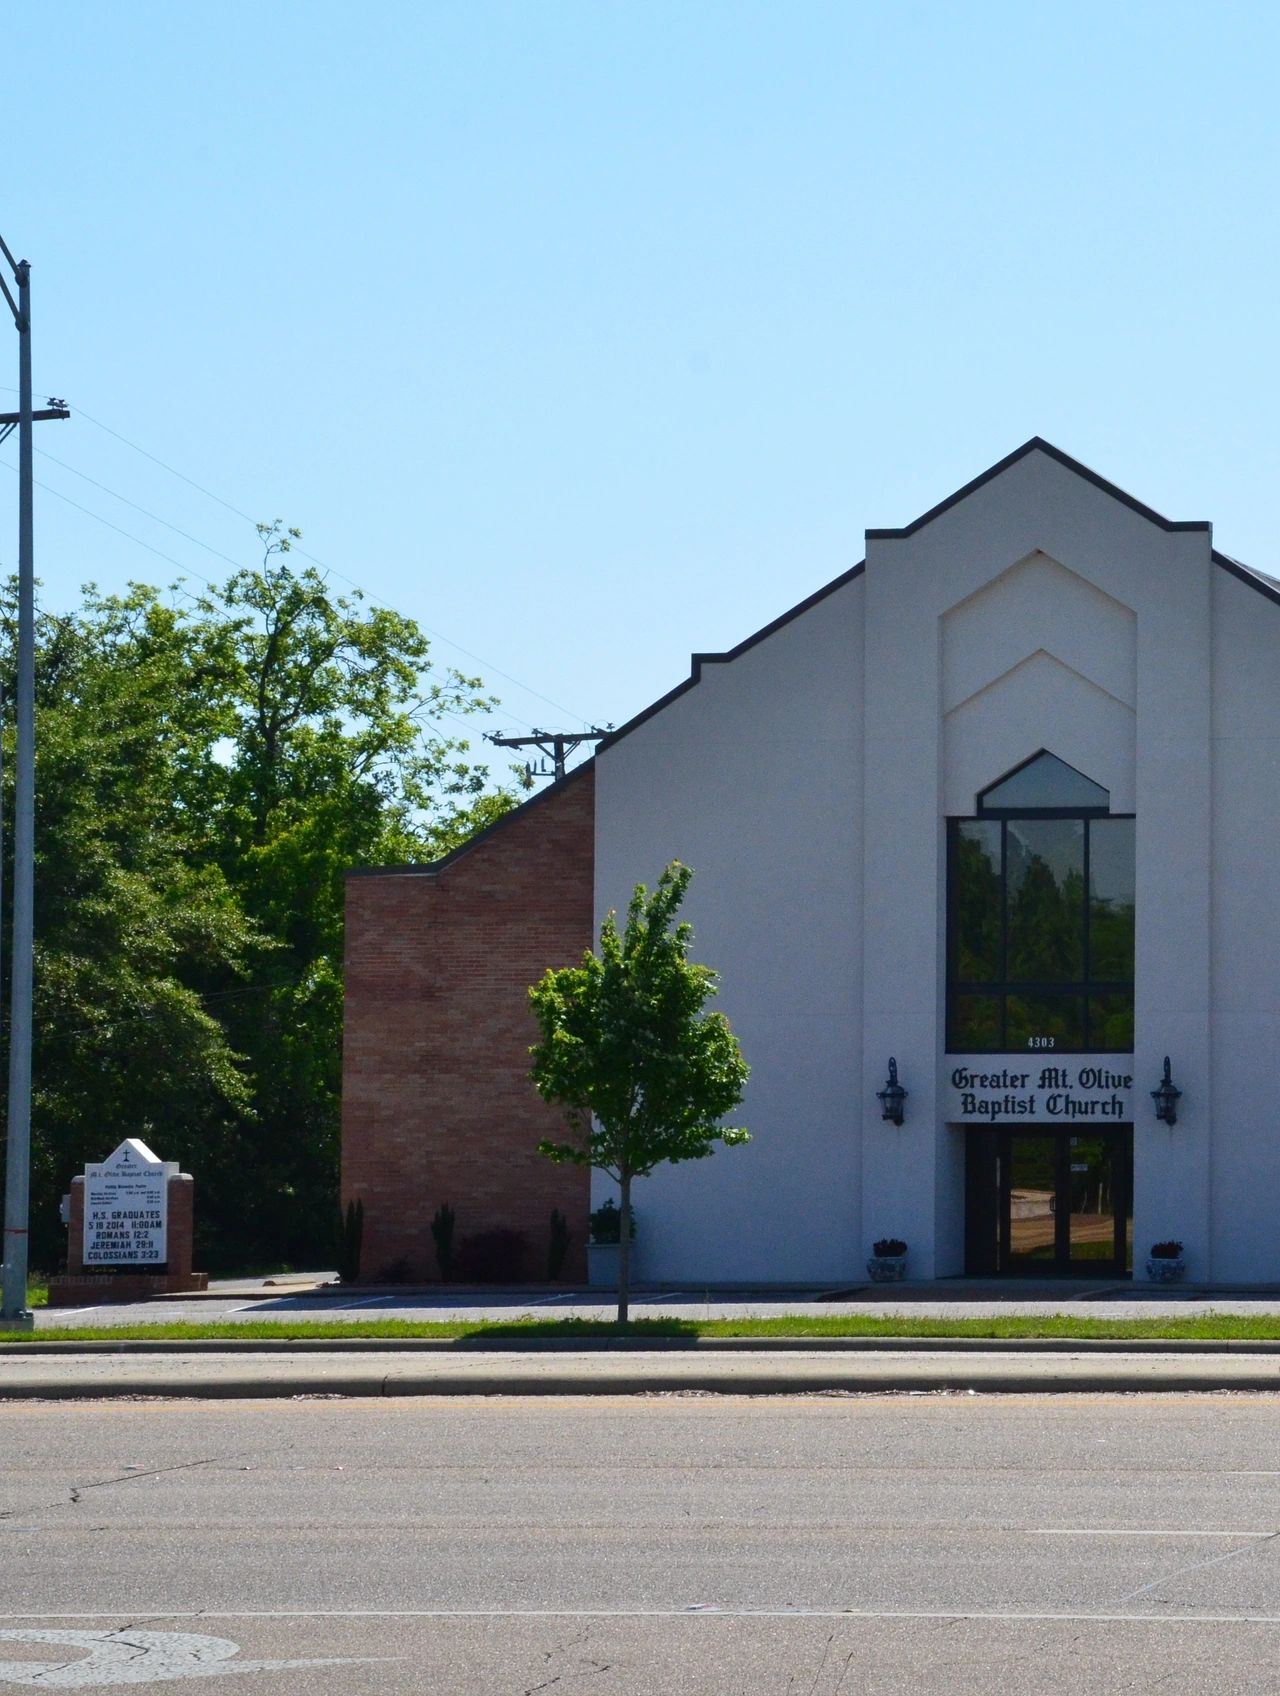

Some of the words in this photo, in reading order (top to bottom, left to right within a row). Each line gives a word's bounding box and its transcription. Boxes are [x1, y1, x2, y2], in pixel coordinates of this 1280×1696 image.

[1028, 1037, 1055, 1048] 4303
[951, 1067, 1030, 1089] Greater
[1037, 1067, 1073, 1089] Mt.
[1078, 1067, 1134, 1089] Olive
[961, 1093, 1036, 1121] Baptist
[1046, 1093, 1124, 1119] Church
[93, 1211, 108, 1220] H.S.
[111, 1210, 160, 1219] GRADUATES
[89, 1221, 94, 1230] 5
[106, 1221, 124, 1230] 2014
[96, 1231, 130, 1239] ROMANS
[134, 1230, 149, 1239] 12:2
[90, 1240, 131, 1249] JEREMIAH
[88, 1250, 138, 1259] COLOSSIANS
[141, 1250, 159, 1259] 3:23
